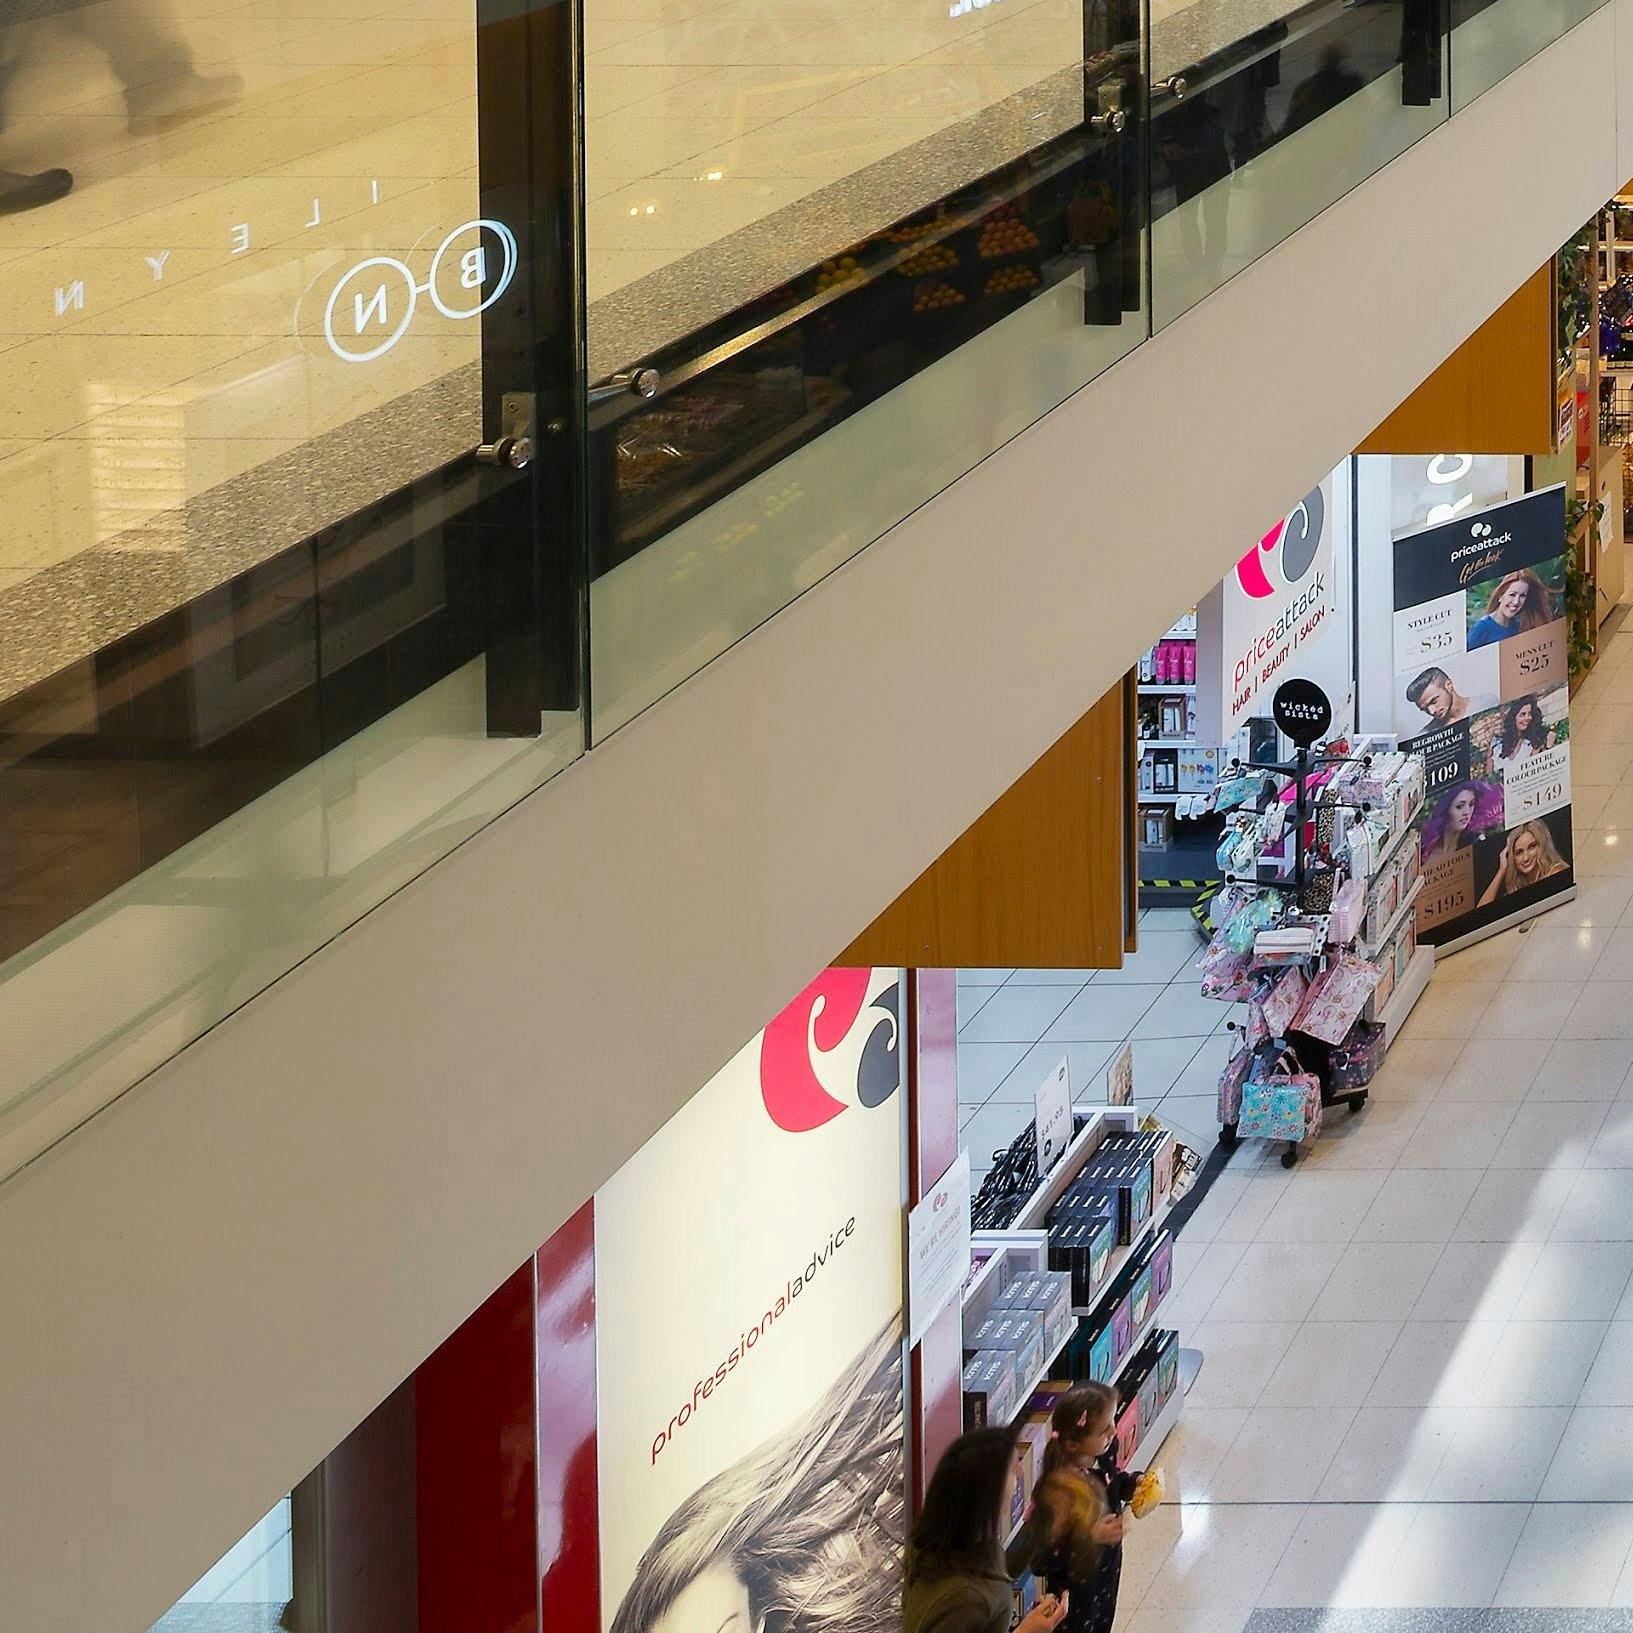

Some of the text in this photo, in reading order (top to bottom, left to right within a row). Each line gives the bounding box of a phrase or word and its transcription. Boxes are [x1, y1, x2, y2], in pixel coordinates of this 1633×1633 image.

[1450, 531, 1513, 563] priceattack
[1232, 570, 1327, 693] priceattack
[1232, 605, 1327, 716] HAIR BEAUTY SALON
[1519, 653, 1550, 676] $25
[1280, 701, 1324, 715] wicked
[1285, 710, 1319, 721] sista
[1412, 727, 1455, 750] REGROWTH
[1432, 732, 1465, 753] PACKAGE
[1424, 890, 1465, 920] $195
[649, 1214, 858, 1467] professionaladvice
